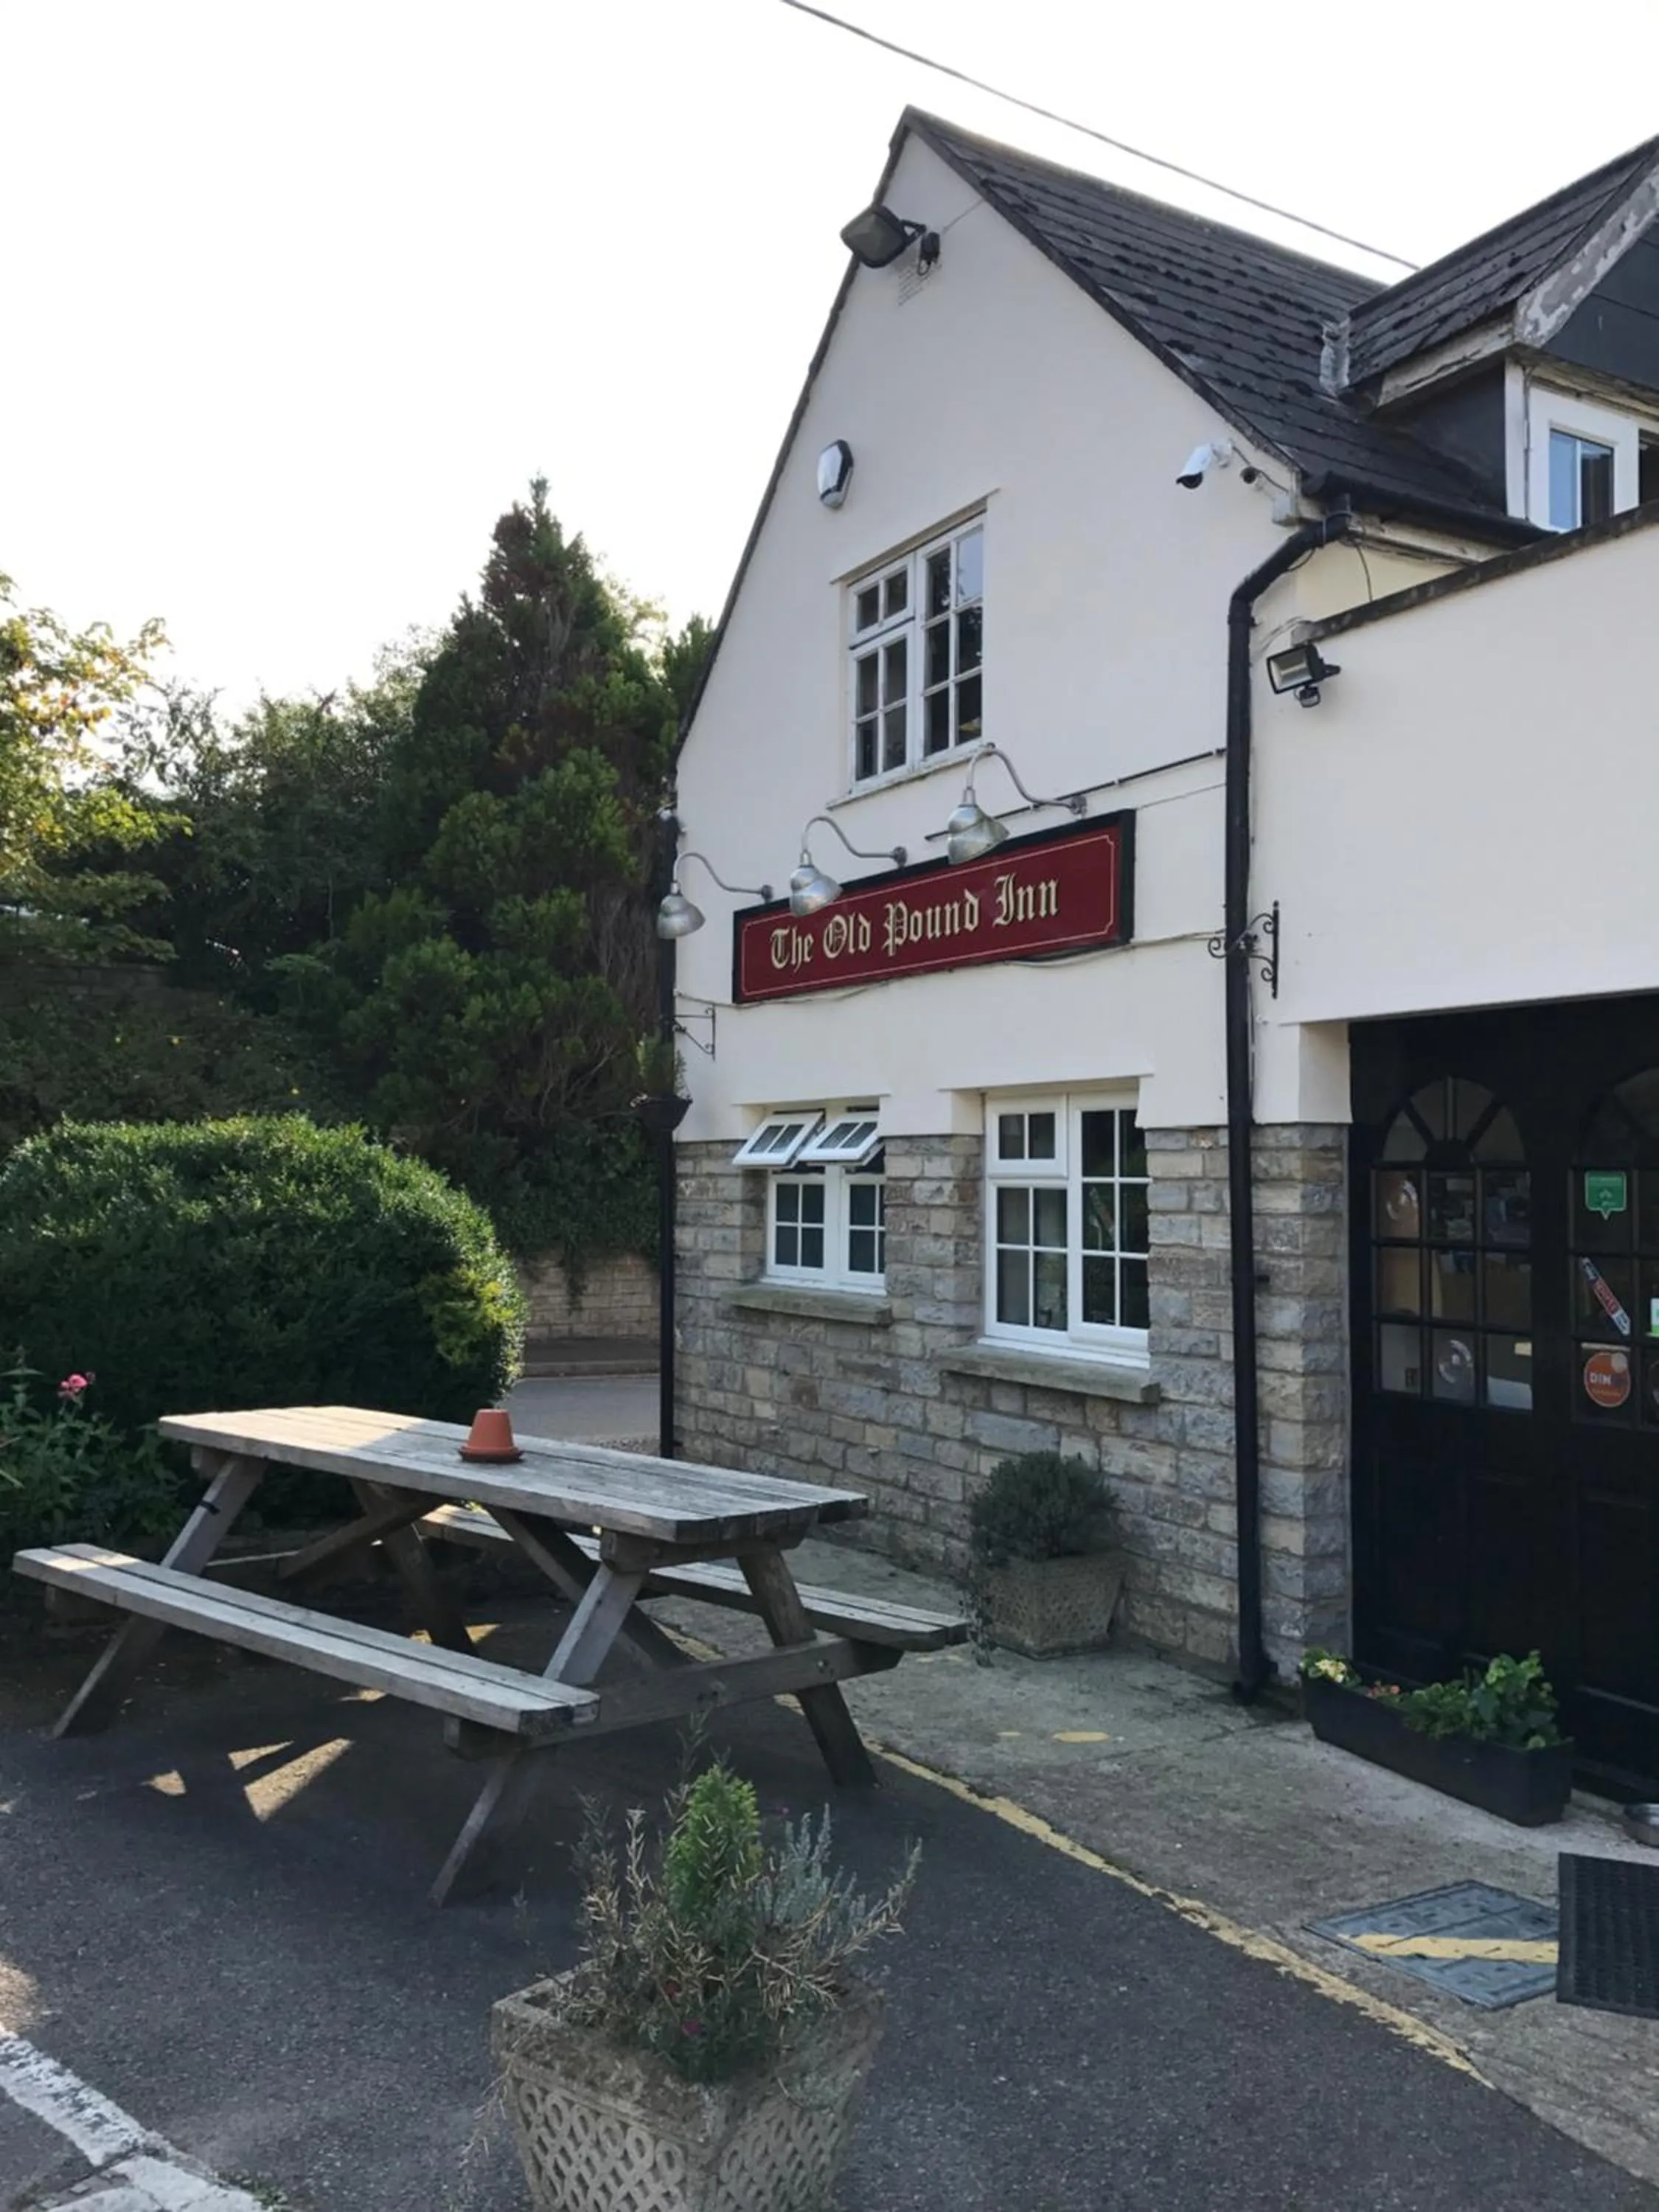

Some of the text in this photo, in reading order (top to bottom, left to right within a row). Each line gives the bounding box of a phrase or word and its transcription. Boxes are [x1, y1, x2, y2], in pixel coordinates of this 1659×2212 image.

[770, 873, 1059, 974] The Old Pound Inn
